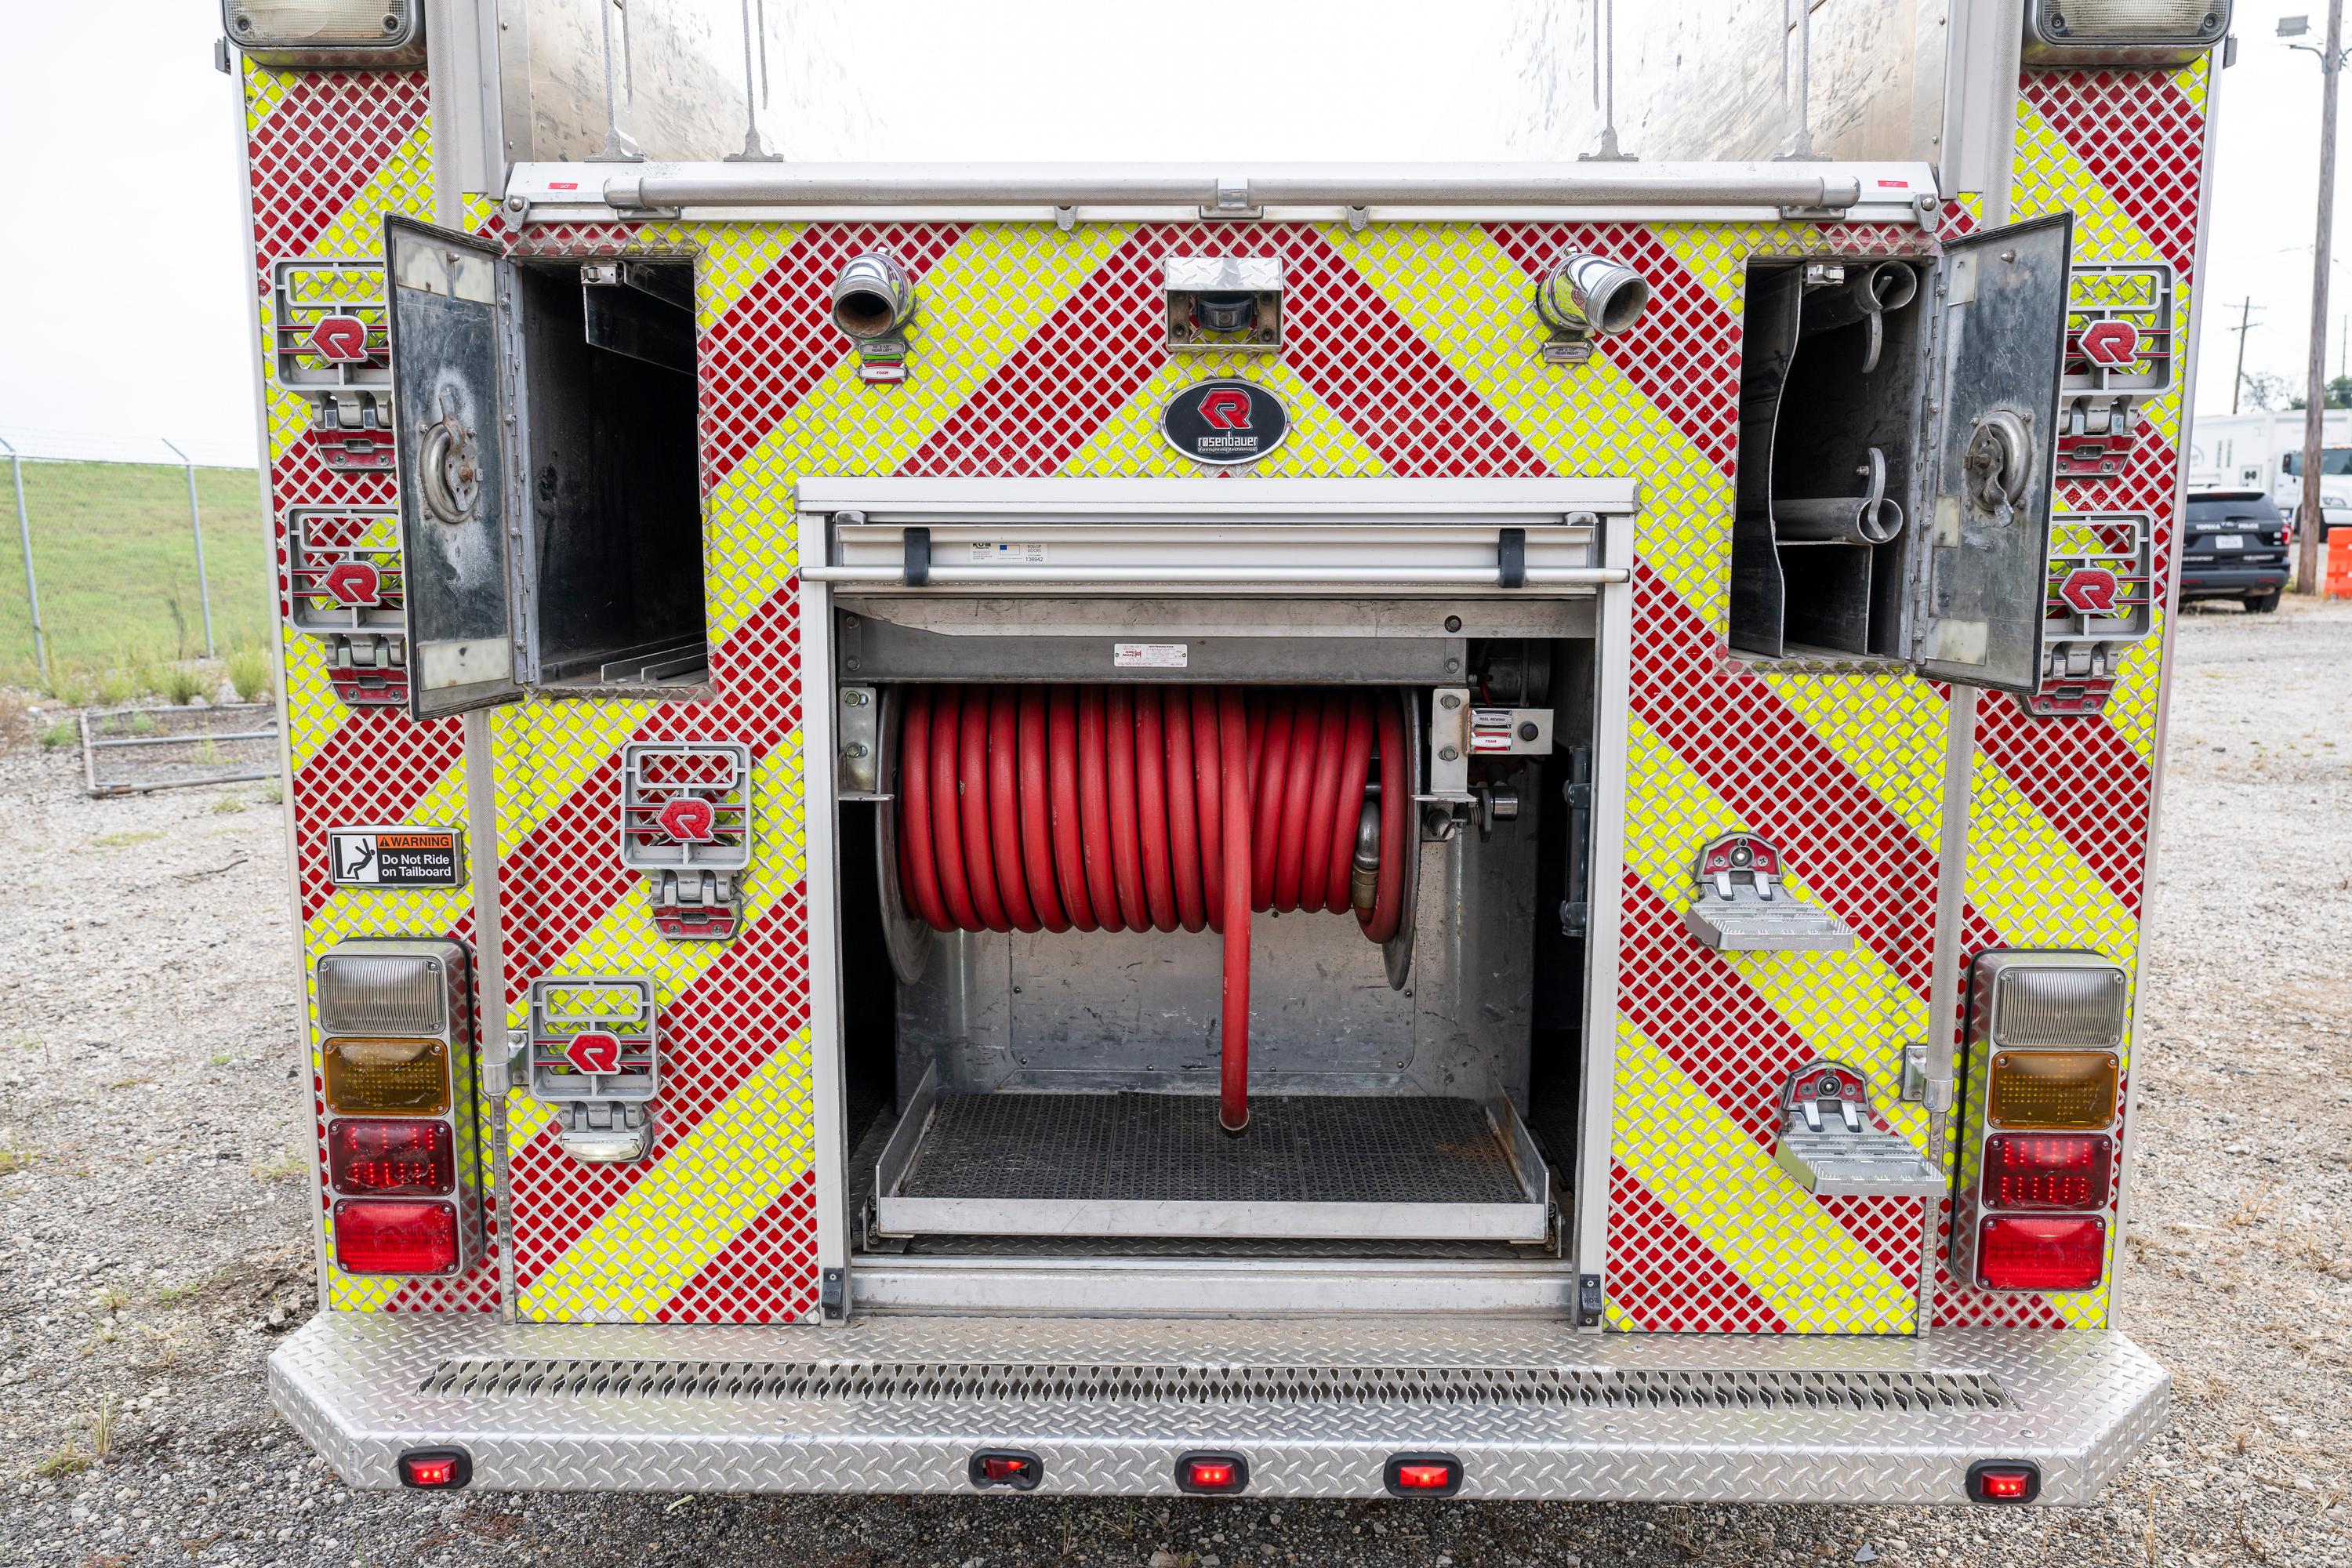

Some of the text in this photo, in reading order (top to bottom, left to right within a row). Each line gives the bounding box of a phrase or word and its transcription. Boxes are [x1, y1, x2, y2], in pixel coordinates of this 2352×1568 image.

[1198, 431, 1258, 447] rosenbauer
[390, 837, 450, 847] WARNING
[382, 854, 450, 865] Do Not Ride
[399, 866, 452, 877] Tailboard
